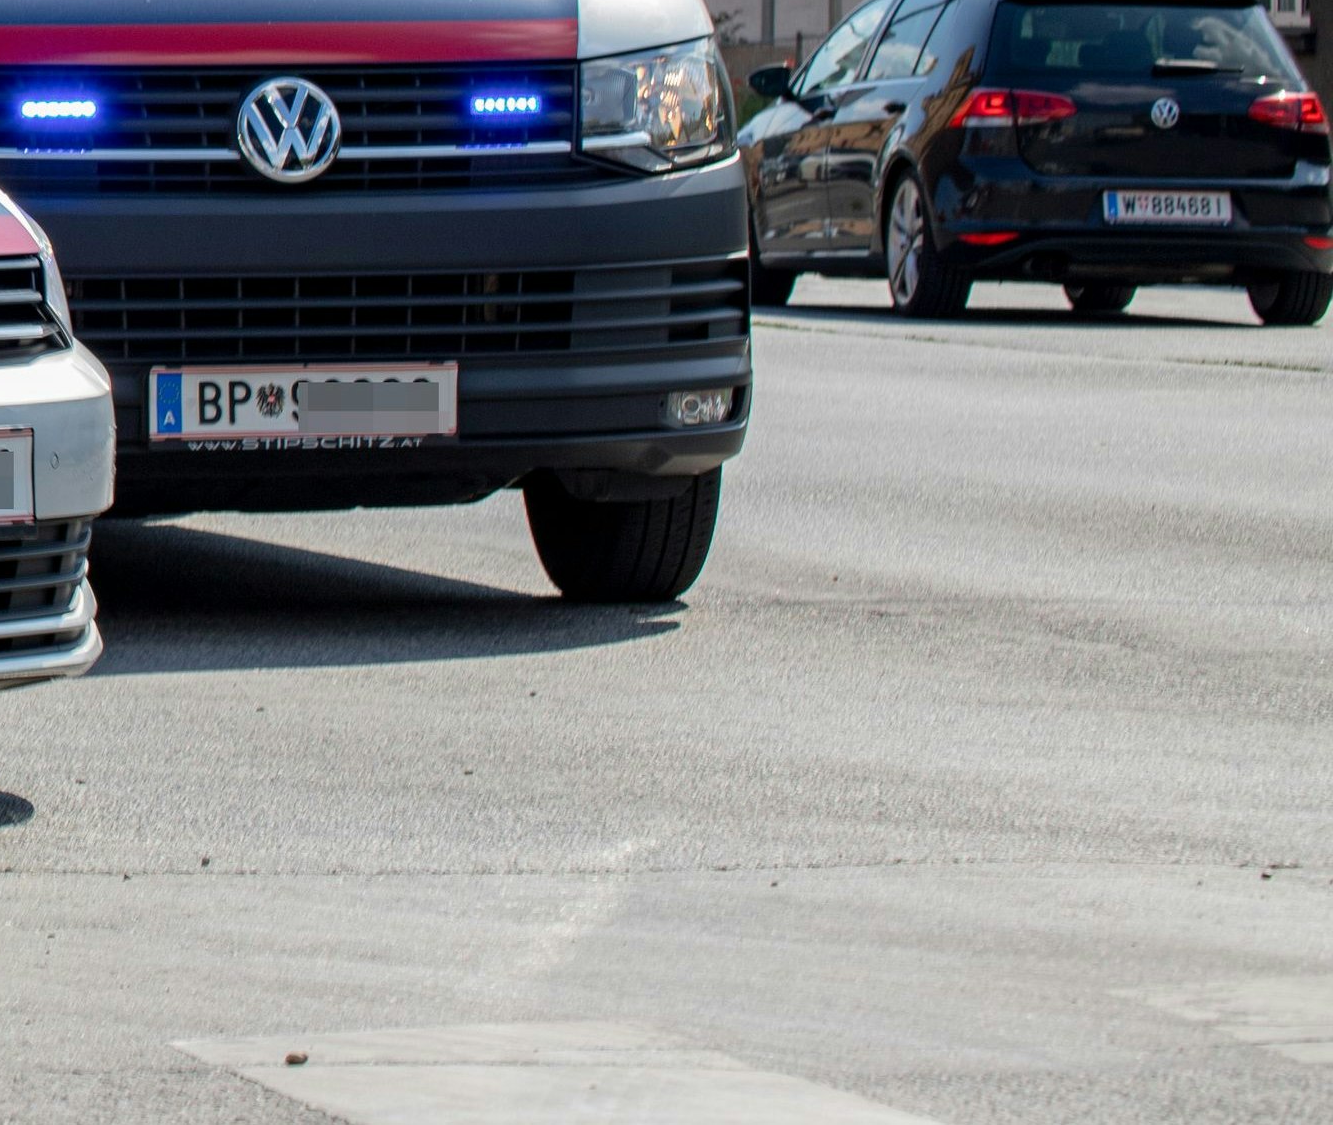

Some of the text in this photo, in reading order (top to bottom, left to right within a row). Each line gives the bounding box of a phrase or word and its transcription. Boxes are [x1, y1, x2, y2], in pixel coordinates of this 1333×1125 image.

[239, 78, 339, 180] VW
[164, 410, 175, 425] A
[198, 380, 251, 425] BP
